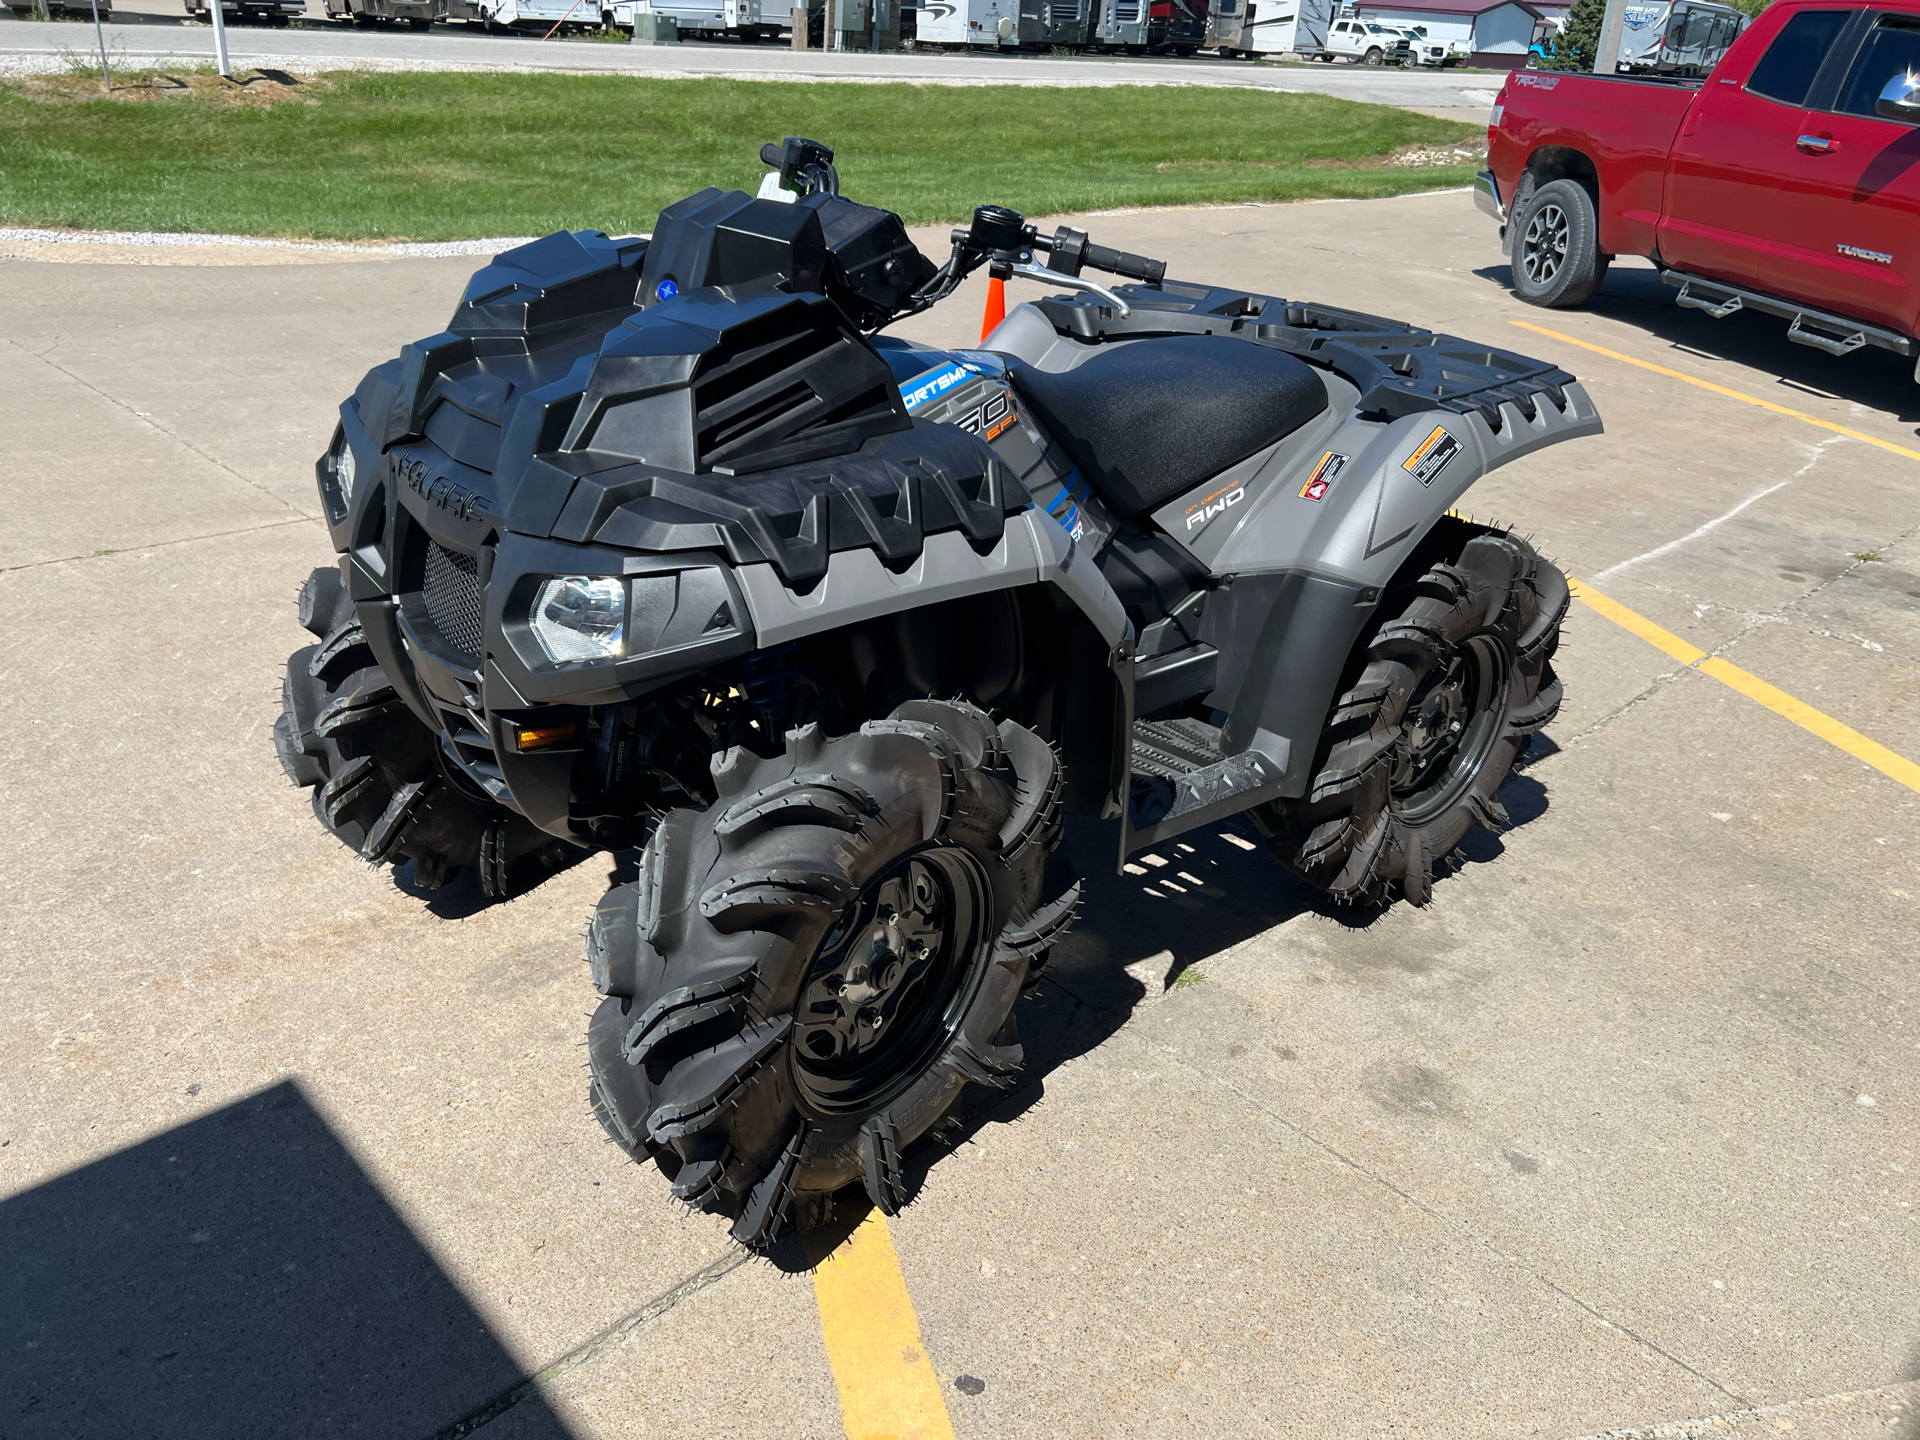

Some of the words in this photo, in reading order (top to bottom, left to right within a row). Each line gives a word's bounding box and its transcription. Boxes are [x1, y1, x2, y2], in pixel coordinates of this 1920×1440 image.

[1514, 74, 1538, 87] TRD
[1836, 243, 1893, 264] TUNDRA
[953, 390, 1009, 435] 50
[987, 412, 1017, 441] EFI
[398, 451, 493, 526] POLARIS
[1186, 487, 1244, 531] AWD
[616, 740, 625, 781] POLARIS
